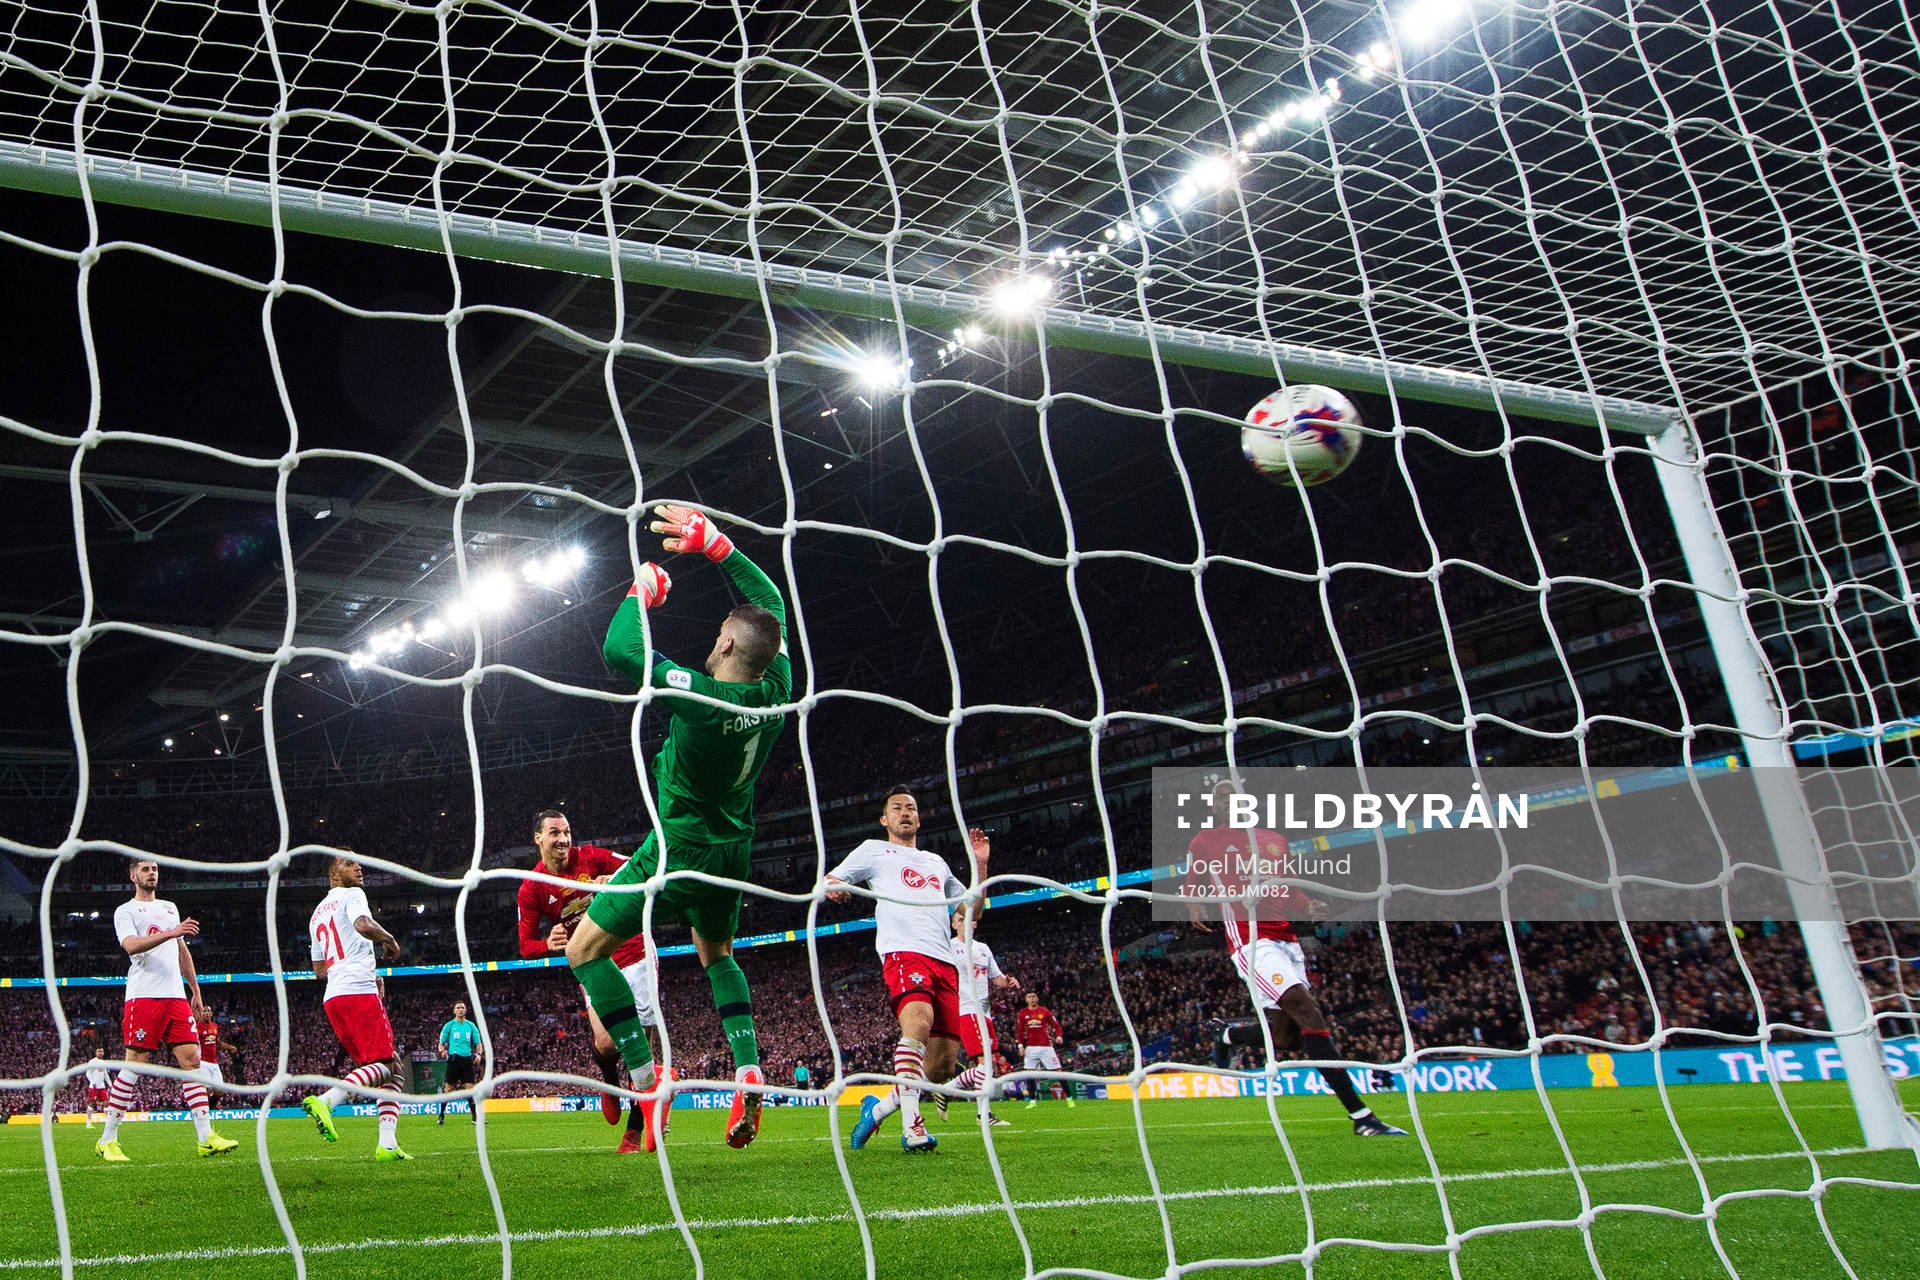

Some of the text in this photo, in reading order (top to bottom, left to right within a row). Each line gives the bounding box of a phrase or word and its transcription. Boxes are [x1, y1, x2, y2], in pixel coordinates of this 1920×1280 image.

[732, 730, 762, 788] 1
[316, 916, 345, 970] 21
[1719, 1050, 1804, 1082] THE
[1146, 1077, 1187, 1098] THE
[1192, 1072, 1299, 1098] FASTEST
[352, 1105, 377, 1116] THE
[692, 1094, 711, 1109] THE
